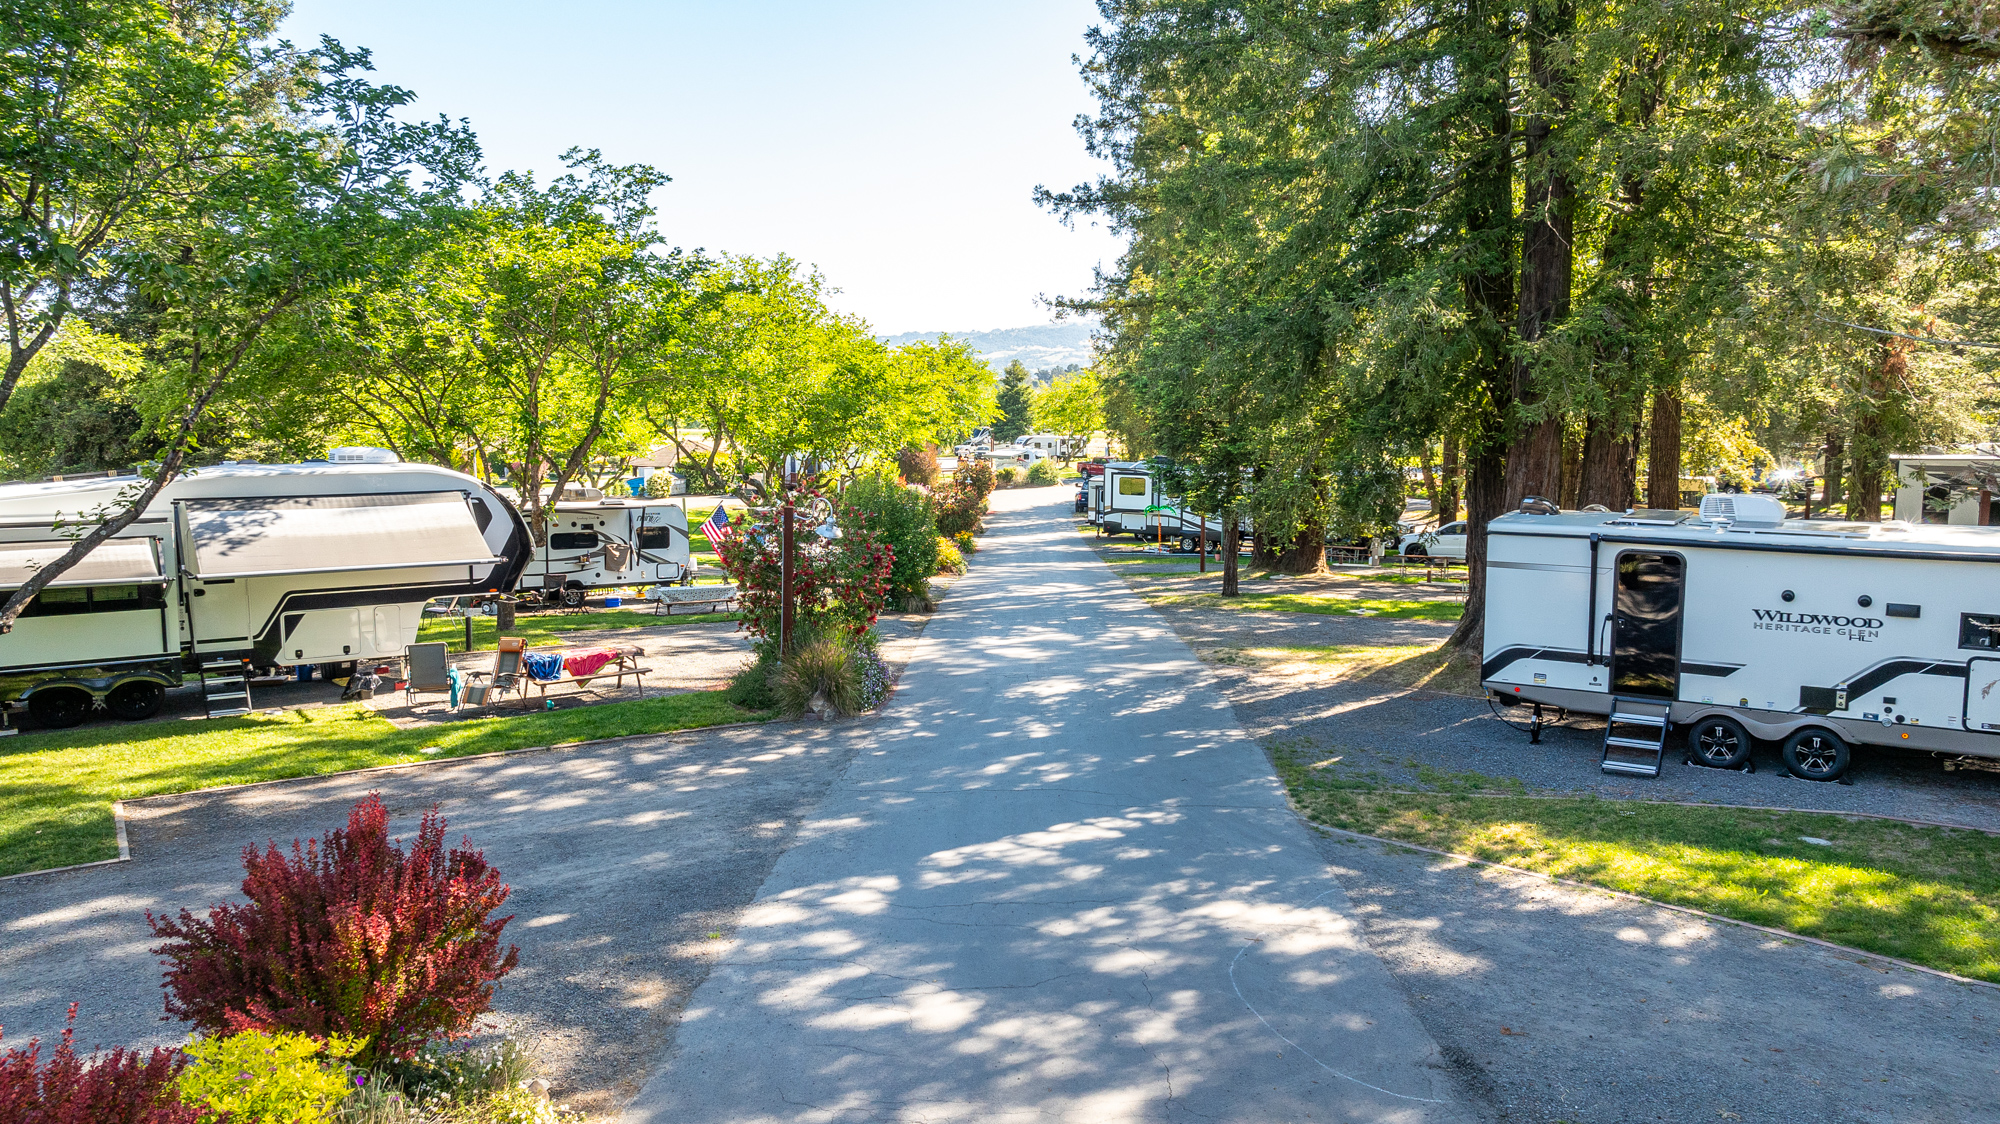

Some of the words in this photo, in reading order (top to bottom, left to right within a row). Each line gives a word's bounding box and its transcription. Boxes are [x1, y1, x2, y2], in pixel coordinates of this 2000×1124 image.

[1752, 609, 1883, 629] WILDWOOD
[1753, 622, 1831, 635] HERITAGE
[1836, 628, 1879, 638] GLEN
